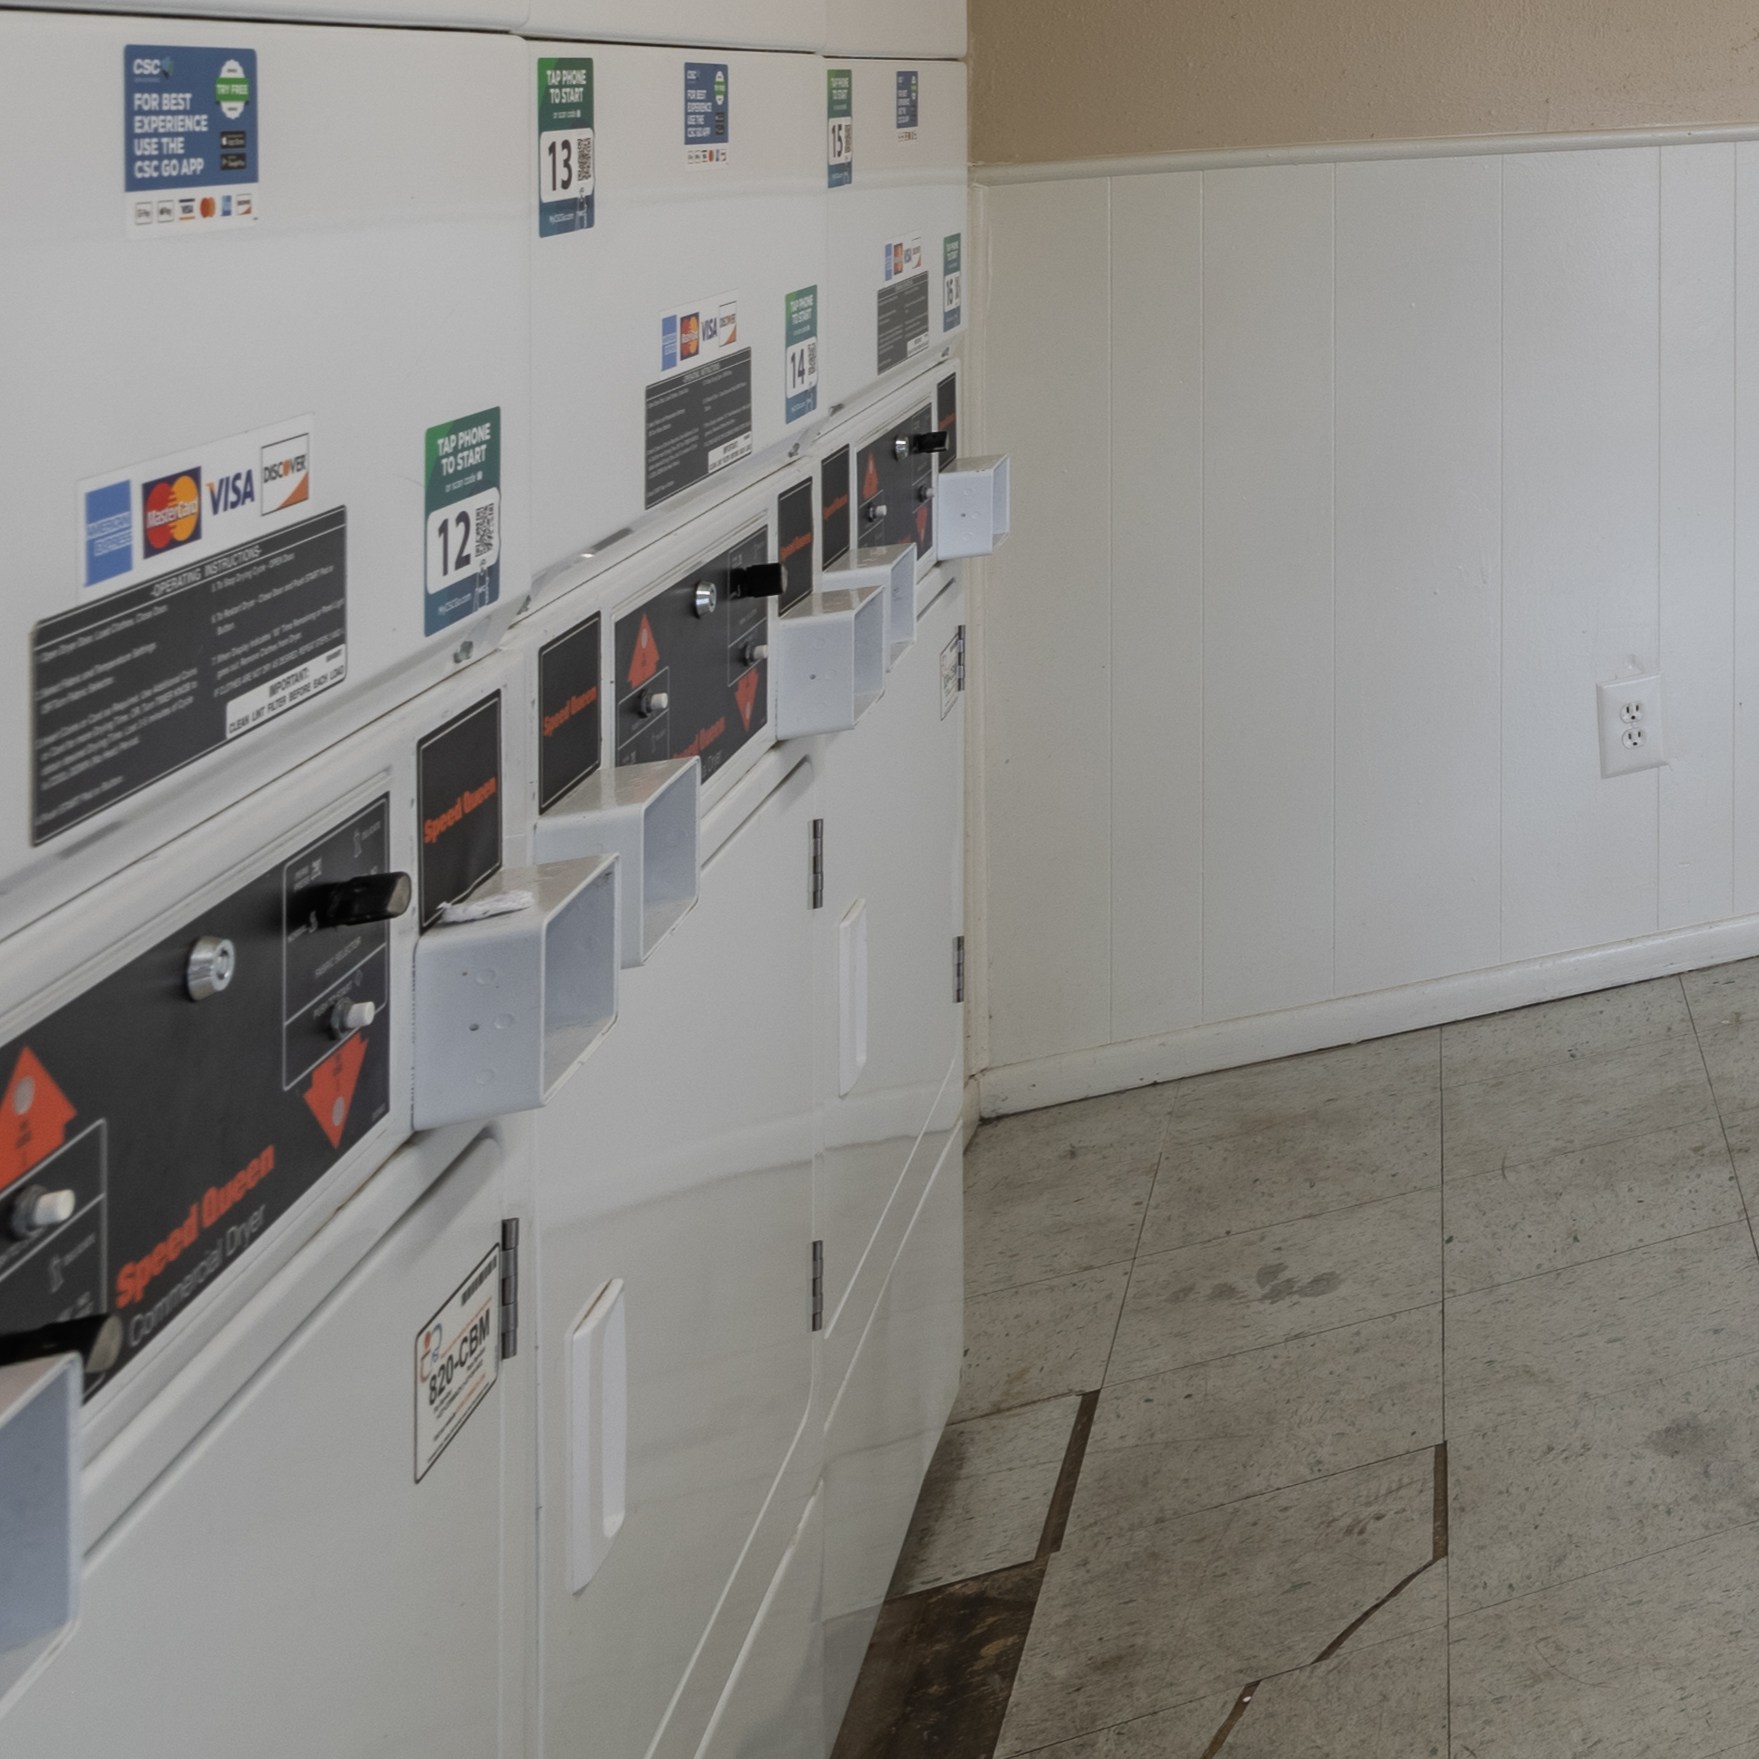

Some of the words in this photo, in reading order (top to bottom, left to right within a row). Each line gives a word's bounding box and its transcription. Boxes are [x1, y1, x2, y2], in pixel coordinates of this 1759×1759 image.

[133, 59, 161, 75] CSC
[546, 70, 561, 86] TAP
[562, 69, 587, 85] PHONE
[133, 93, 160, 111] FOR
[162, 92, 192, 111] BEST
[216, 83, 230, 95] TRY
[231, 83, 248, 95] FREE
[550, 88, 561, 104] TO
[561, 87, 584, 104] START
[133, 115, 209, 133] EXPERIENCE
[831, 123, 843, 158] 15
[134, 137, 159, 156] USE
[162, 136, 185, 154] THE
[134, 159, 159, 178] CSC
[161, 158, 179, 177] GO
[180, 157, 204, 176] APP
[548, 139, 573, 191] 13
[700, 317, 718, 342] VISA
[790, 348, 805, 389] 14
[437, 434, 456, 456] TAP
[458, 422, 491, 449] PHONE
[263, 454, 307, 484] DISCOVER
[441, 456, 455, 476] TO
[456, 444, 487, 471] START
[205, 468, 255, 516] VISA
[146, 499, 199, 529] MasterCard
[438, 510, 471, 577] 12
[229, 714, 250, 734] CLEAN
[252, 706, 265, 721] LINT
[267, 695, 287, 714] FILTER
[289, 682, 311, 702] BEFORE
[313, 673, 328, 689] EACH
[330, 664, 344, 680] LOAD
[543, 699, 570, 737] Speed
[570, 685, 597, 716] Queen
[423, 796, 463, 844] Speed
[463, 776, 497, 814] Queen
[115, 1201, 199, 1309] Speed
[202, 1143, 275, 1229] Queen
[128, 1238, 223, 1348] Commercial
[225, 1203, 266, 1257] Dryer
[428, 1307, 490, 1406] 820-CBM
